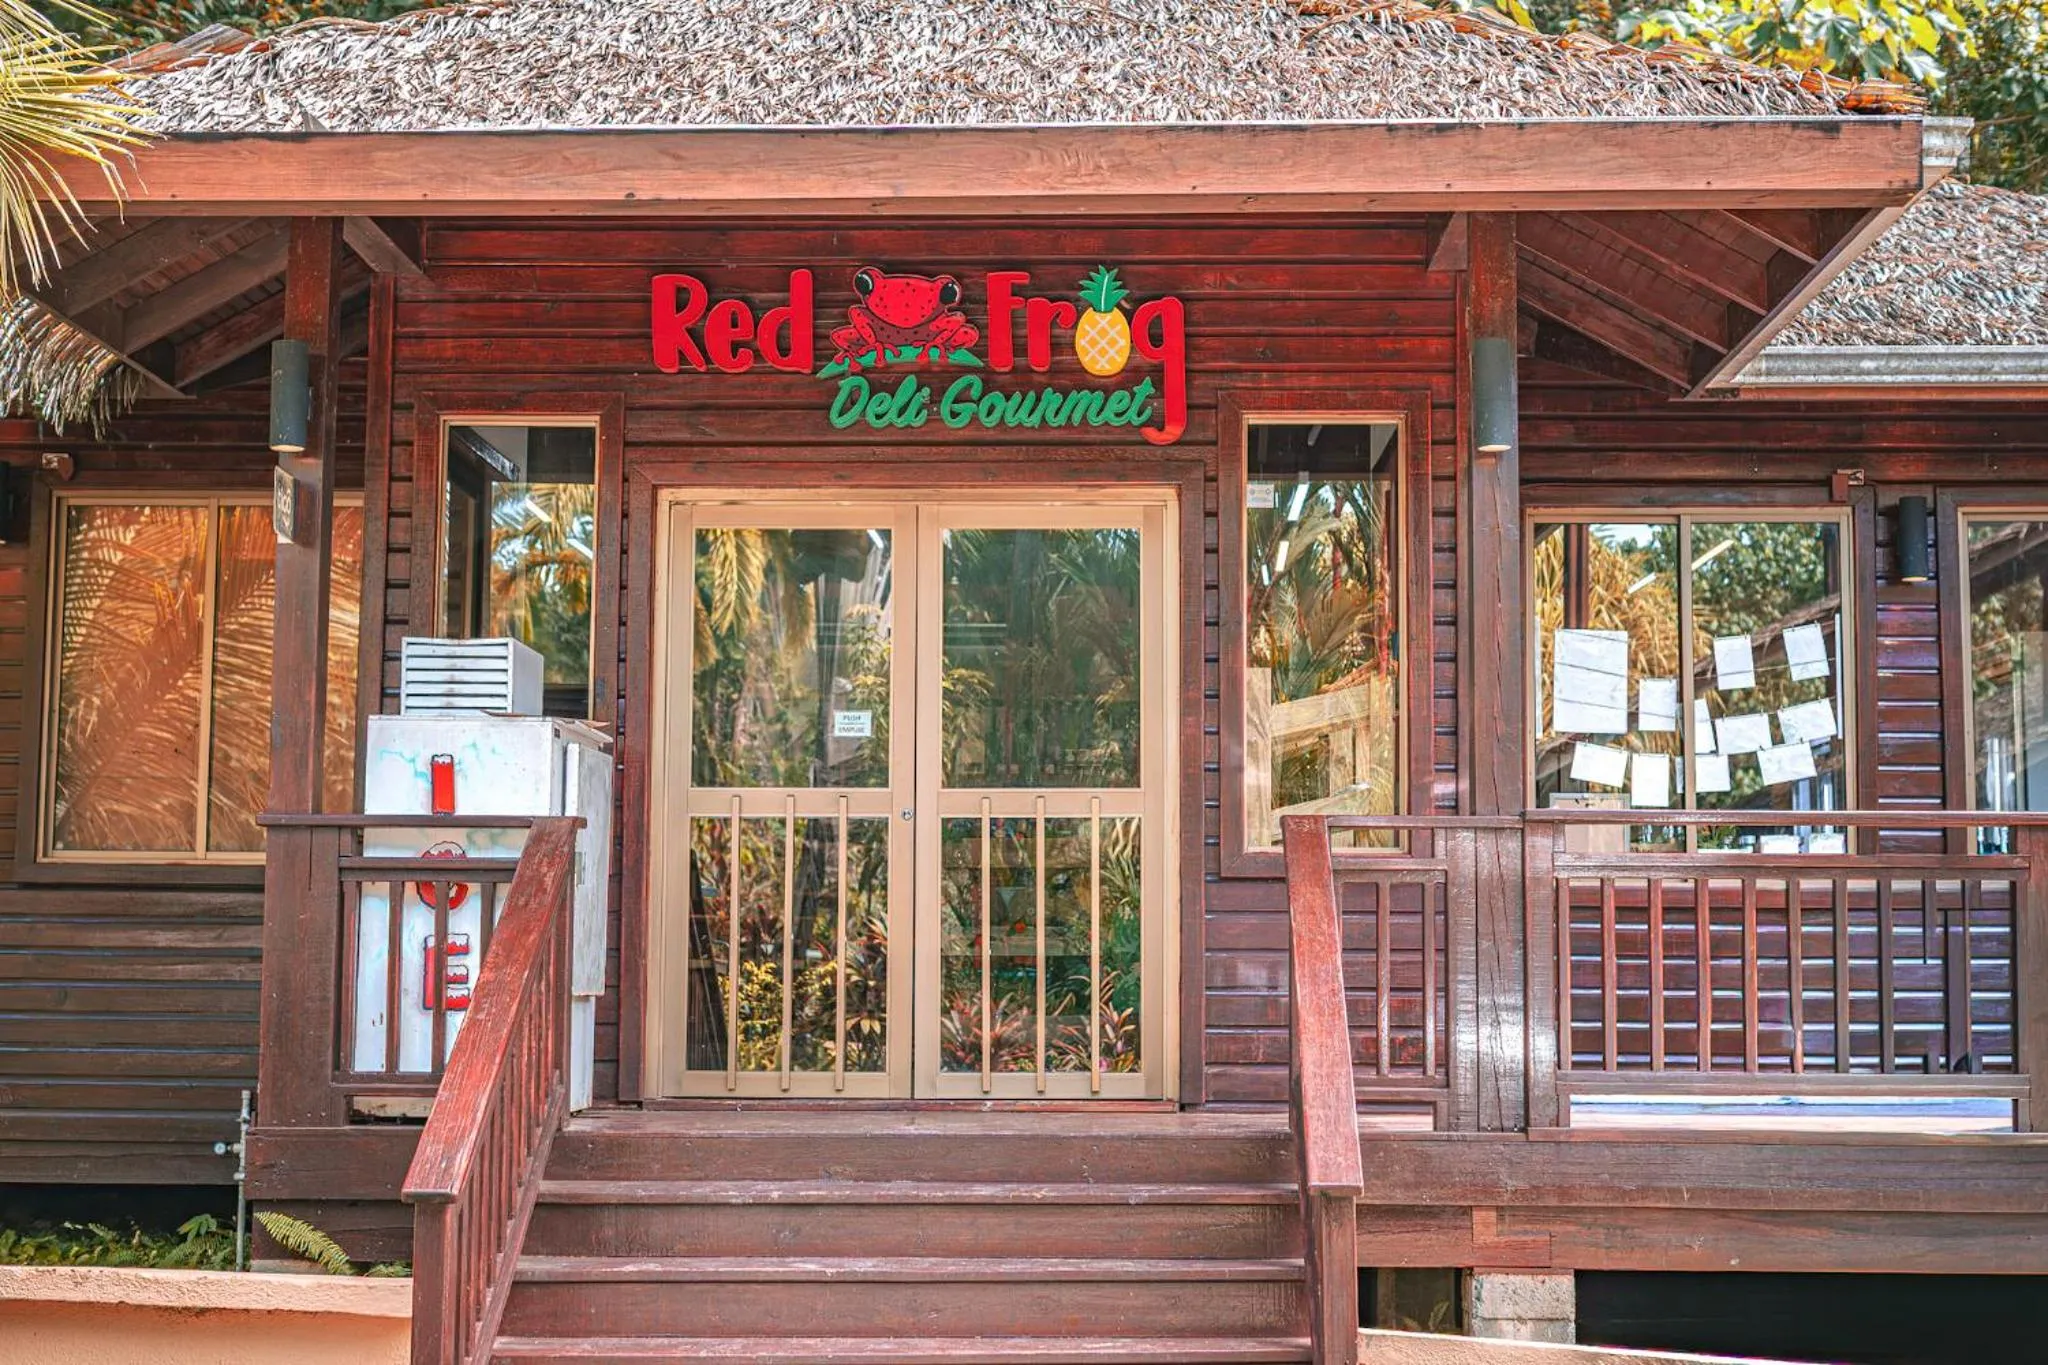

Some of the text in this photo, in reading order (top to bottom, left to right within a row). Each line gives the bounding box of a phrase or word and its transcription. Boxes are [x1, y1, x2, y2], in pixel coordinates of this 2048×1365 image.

[651, 269, 813, 374] Red
[828, 374, 1156, 429] Deli Gourmet
[415, 753, 471, 1012] ICE
